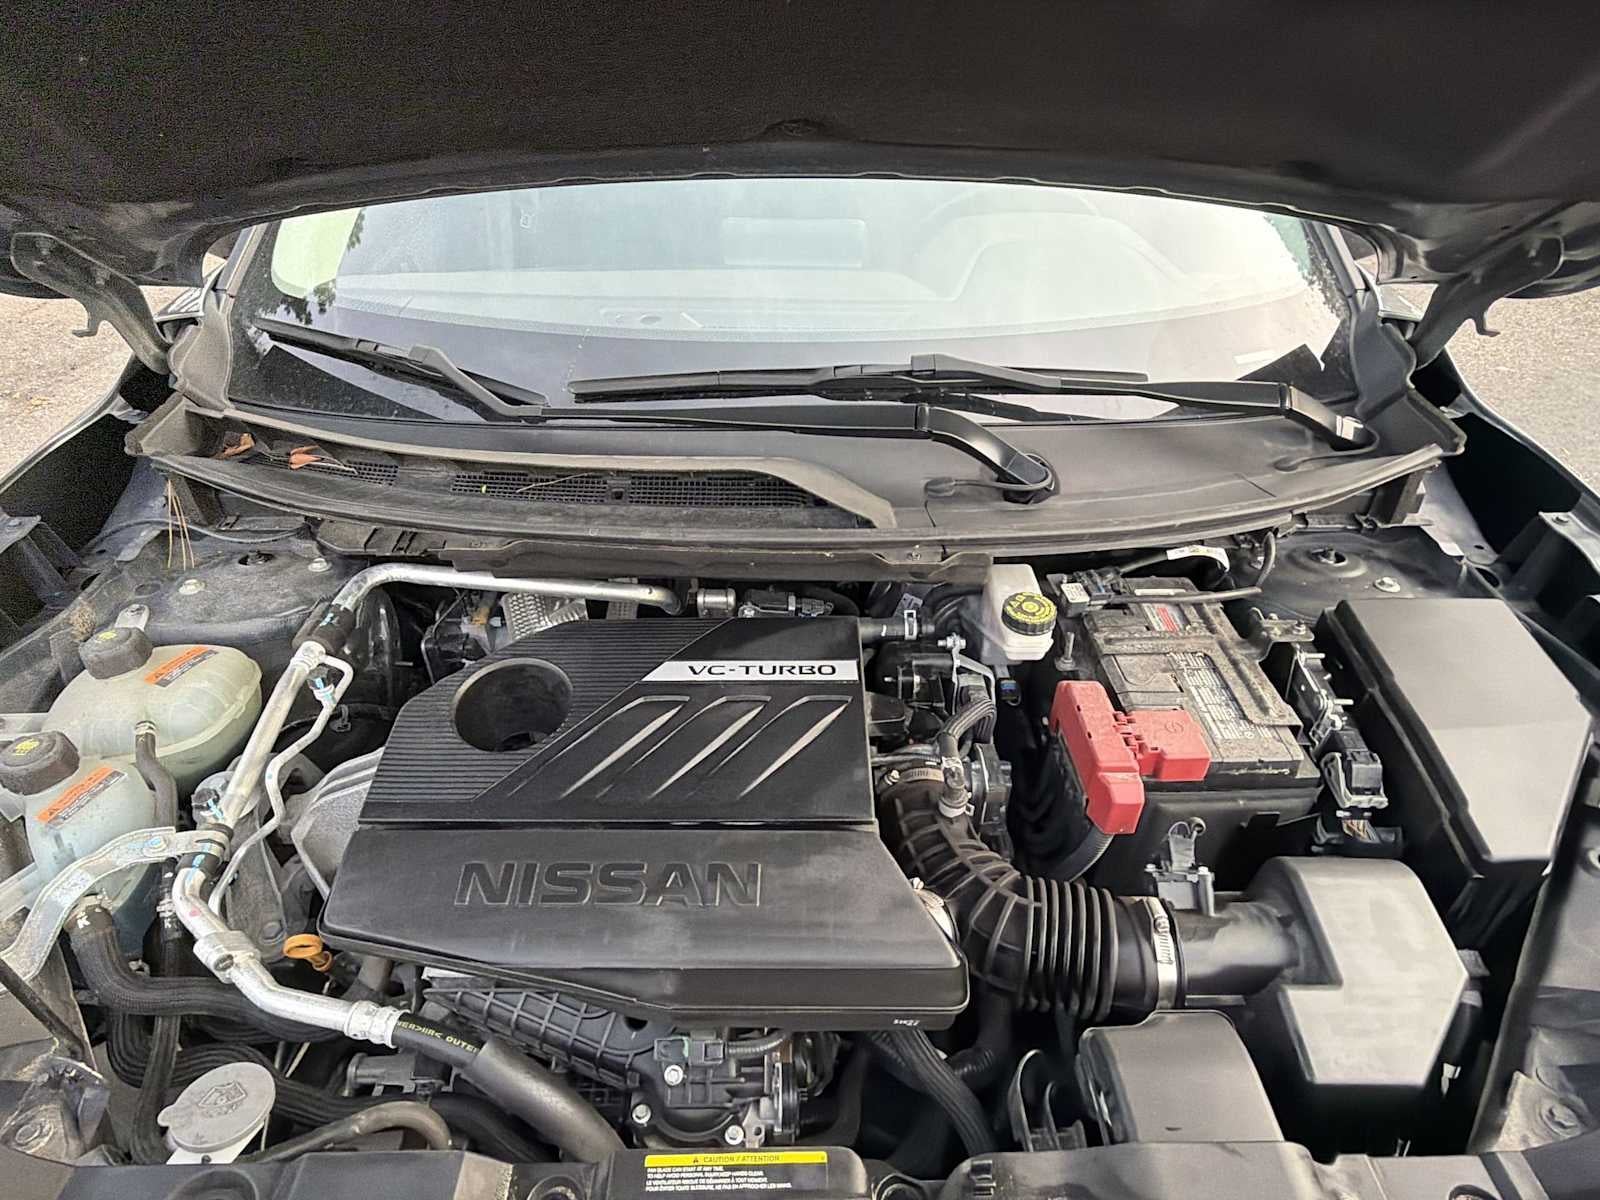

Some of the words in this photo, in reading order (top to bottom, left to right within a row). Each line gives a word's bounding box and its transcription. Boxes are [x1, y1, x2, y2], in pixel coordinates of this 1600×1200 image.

[687, 664, 836, 676] VC-TURBO
[453, 860, 763, 907] NISSAN
[741, 1154, 780, 1162] ATTENTION
